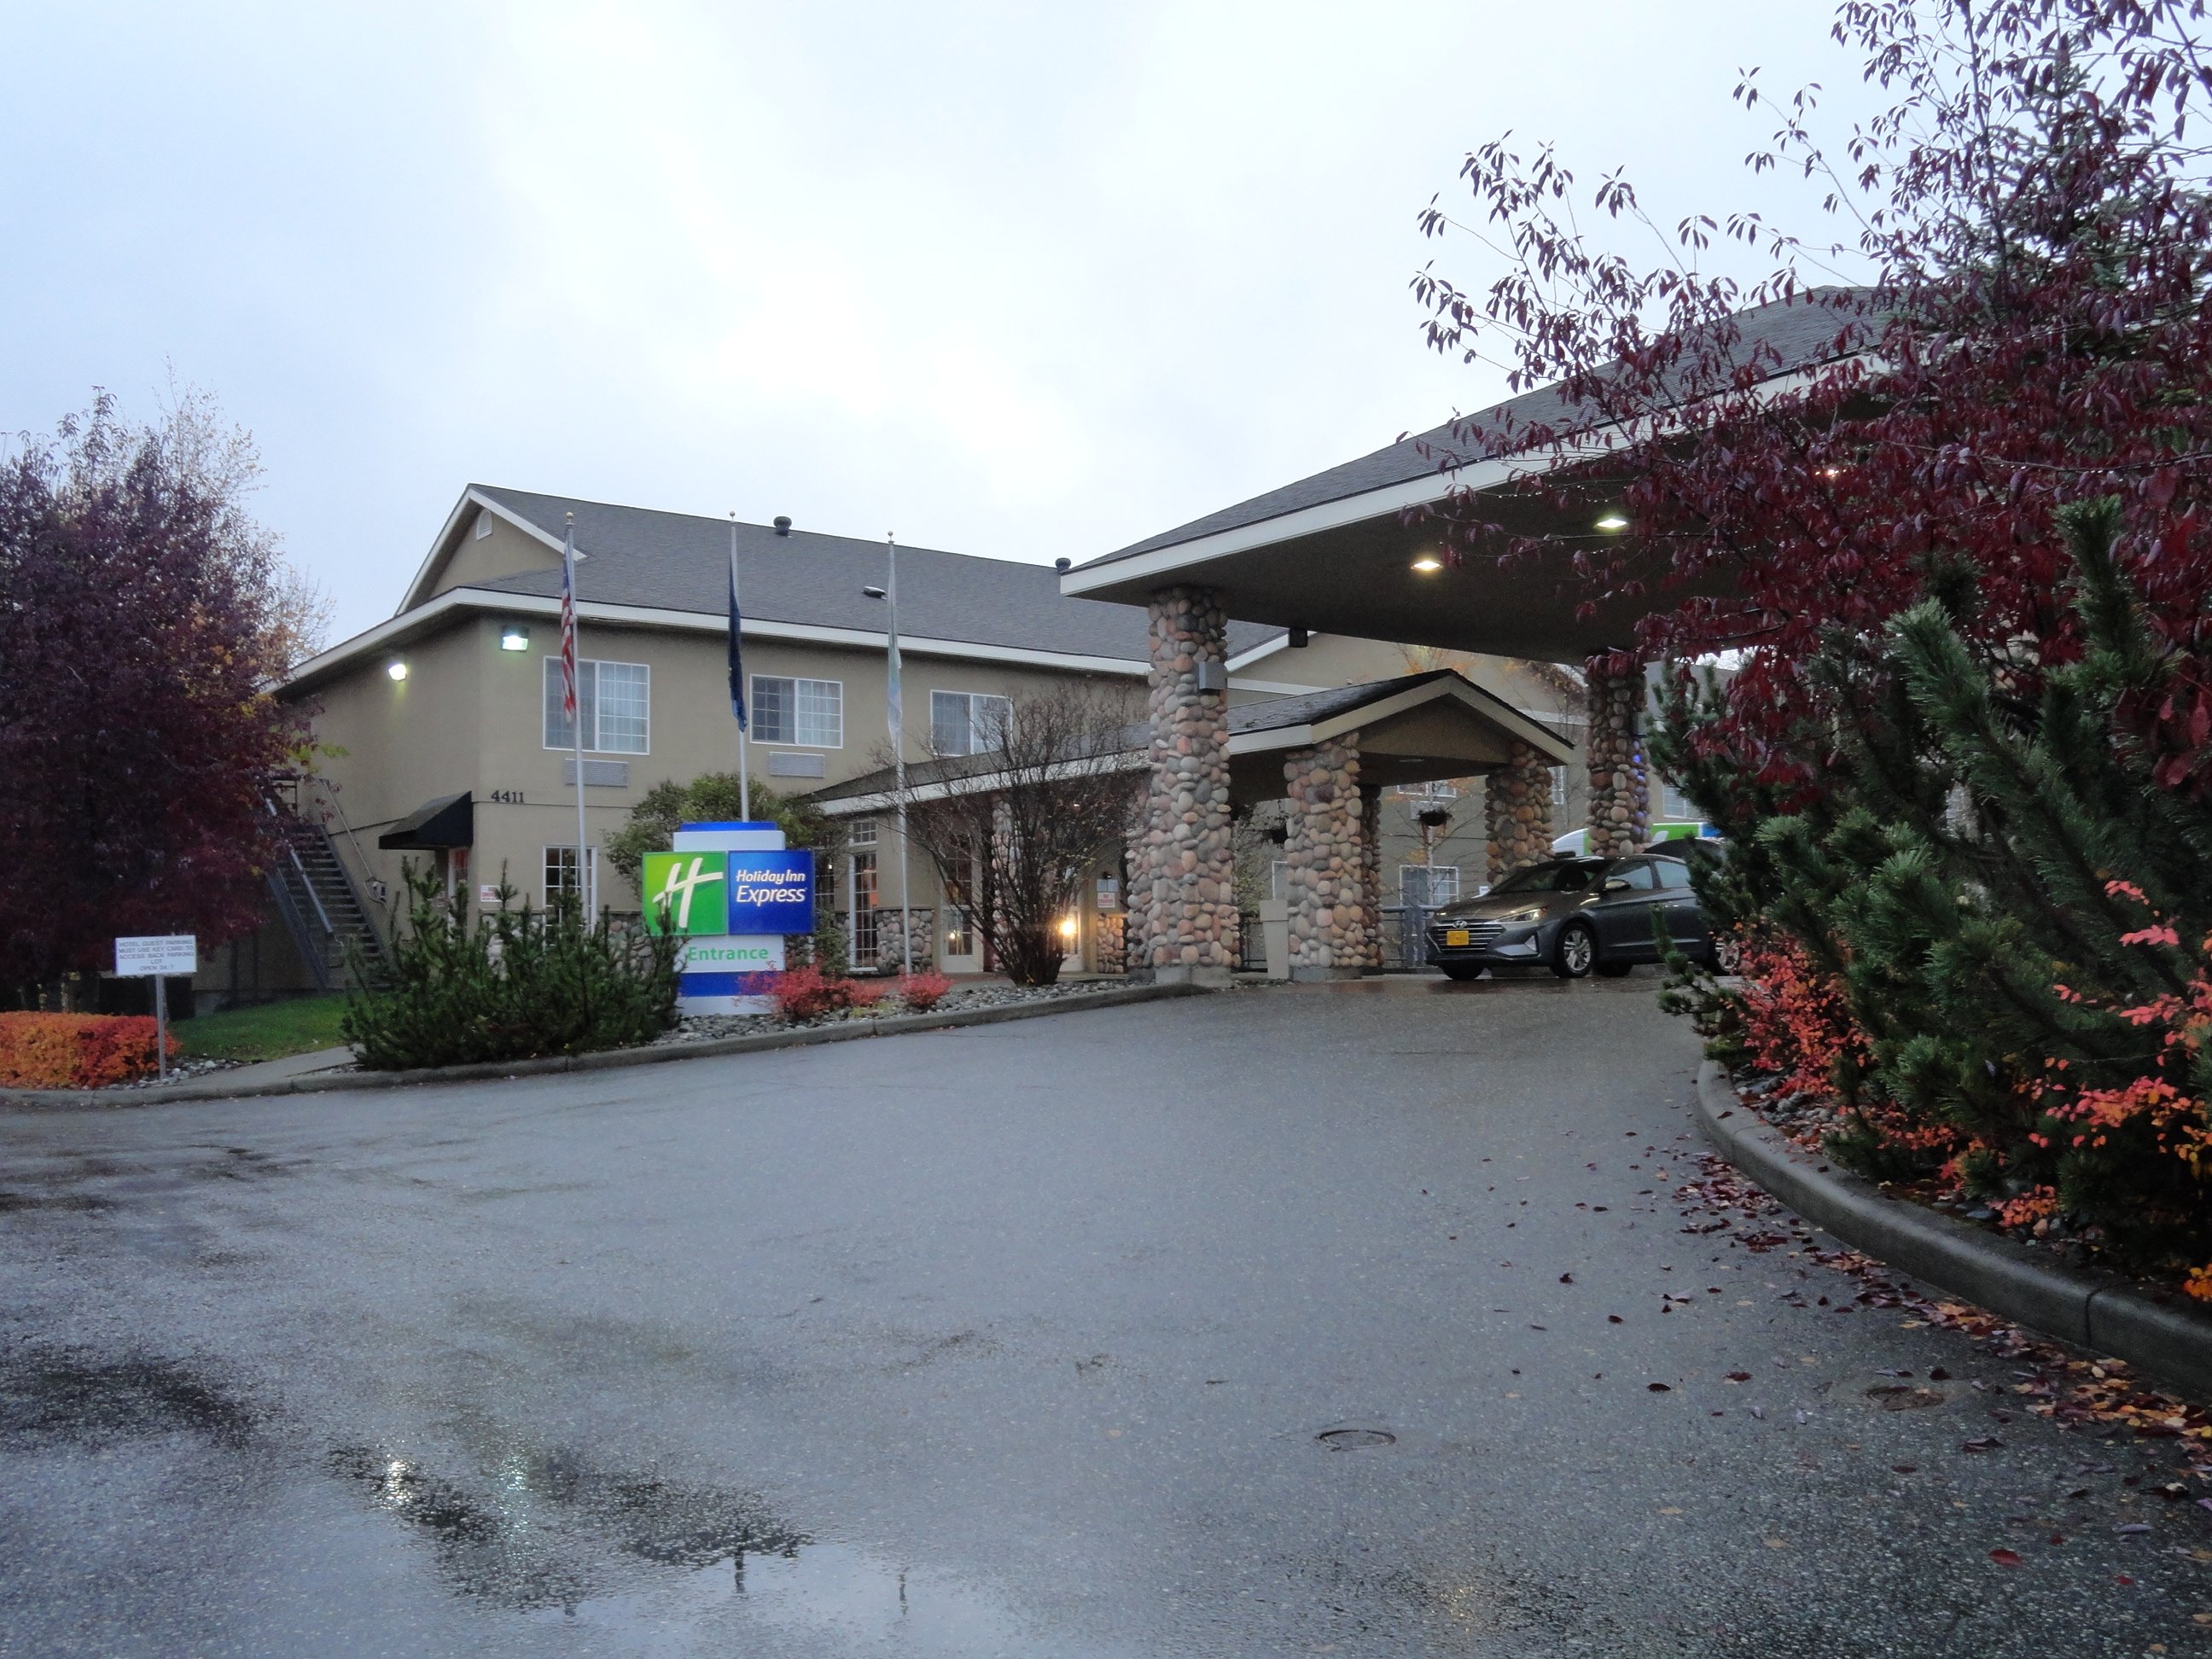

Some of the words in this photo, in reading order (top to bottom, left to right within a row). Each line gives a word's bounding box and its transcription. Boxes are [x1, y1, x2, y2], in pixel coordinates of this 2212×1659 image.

[491, 790, 524, 803] 4411
[736, 869, 784, 884] Holiday
[785, 869, 806, 882] Inn
[736, 885, 807, 906] Express
[688, 946, 768, 961] Entrance
